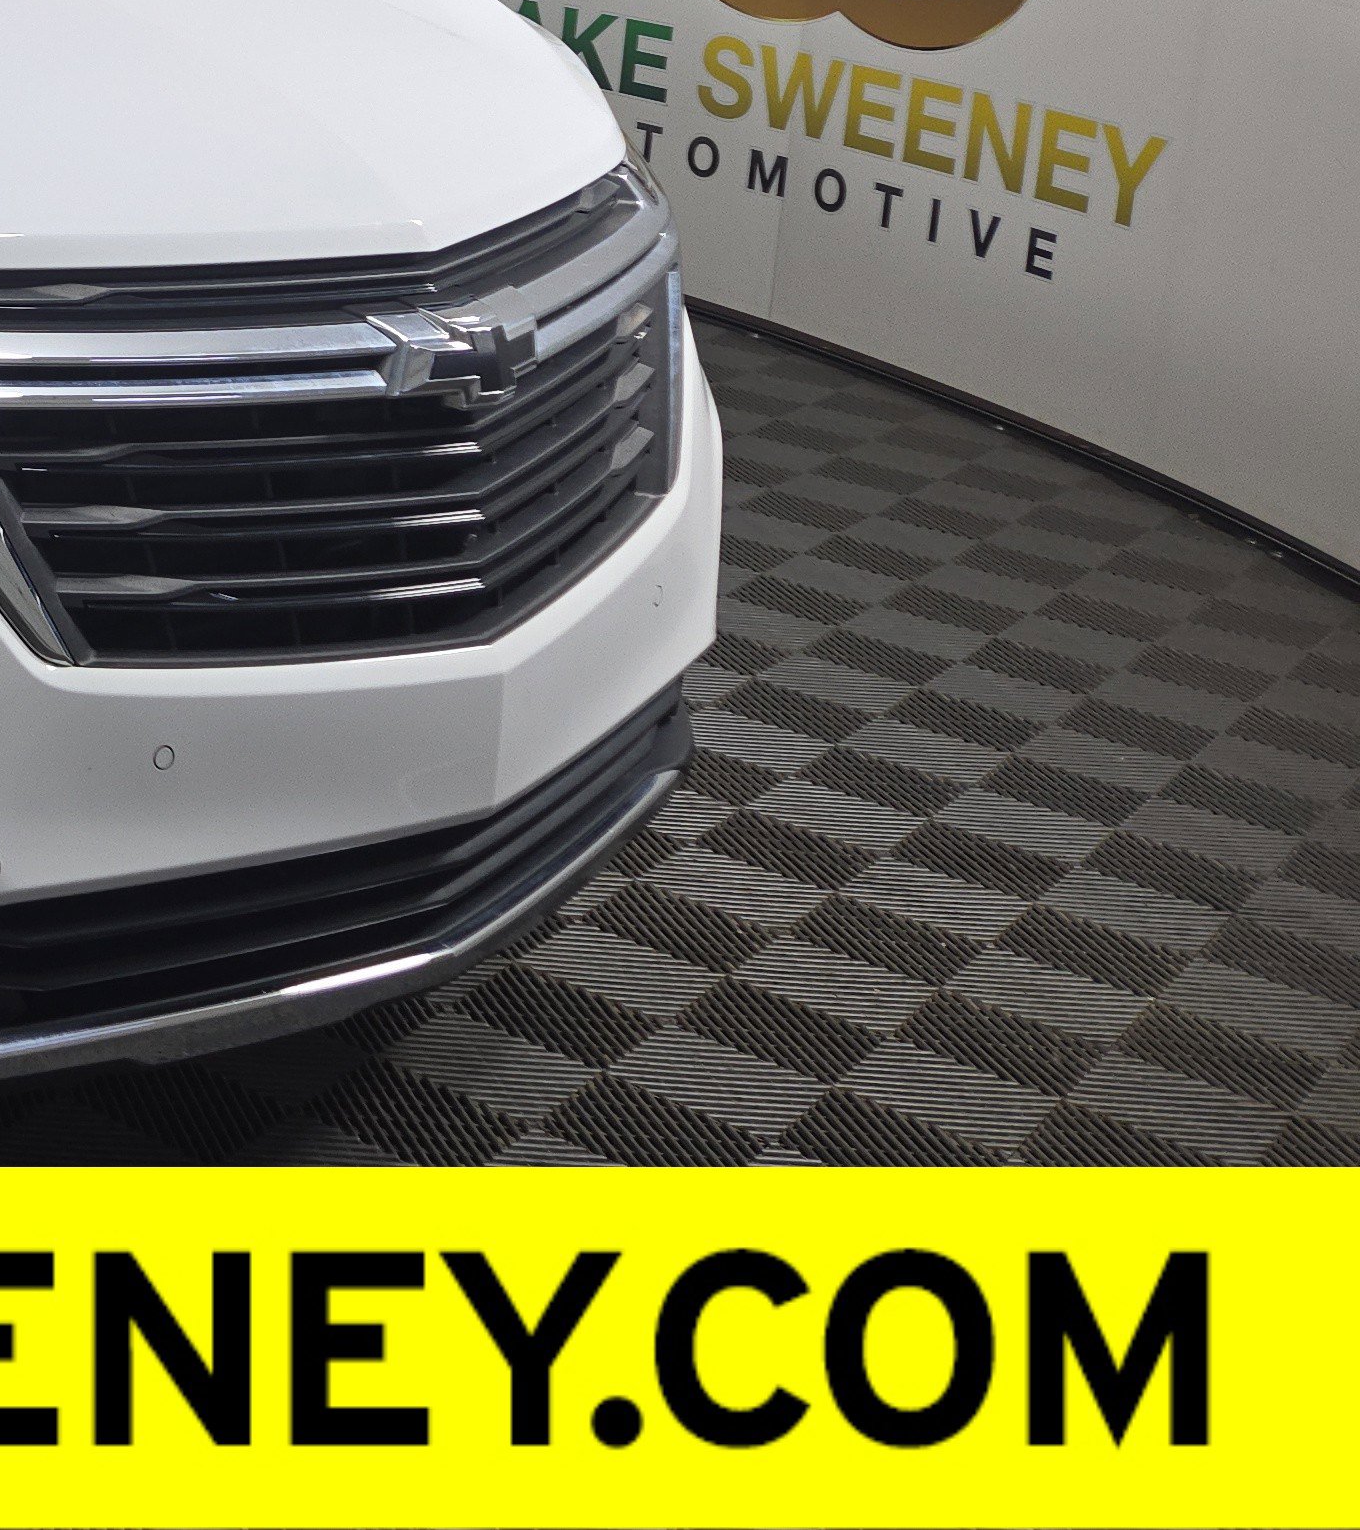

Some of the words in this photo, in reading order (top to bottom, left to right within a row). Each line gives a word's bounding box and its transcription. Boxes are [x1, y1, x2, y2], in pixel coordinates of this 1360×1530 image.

[516, 0, 674, 103] KE
[697, 35, 1168, 227] SWEENEY
[636, 121, 1058, 280] TOMOTIVE
